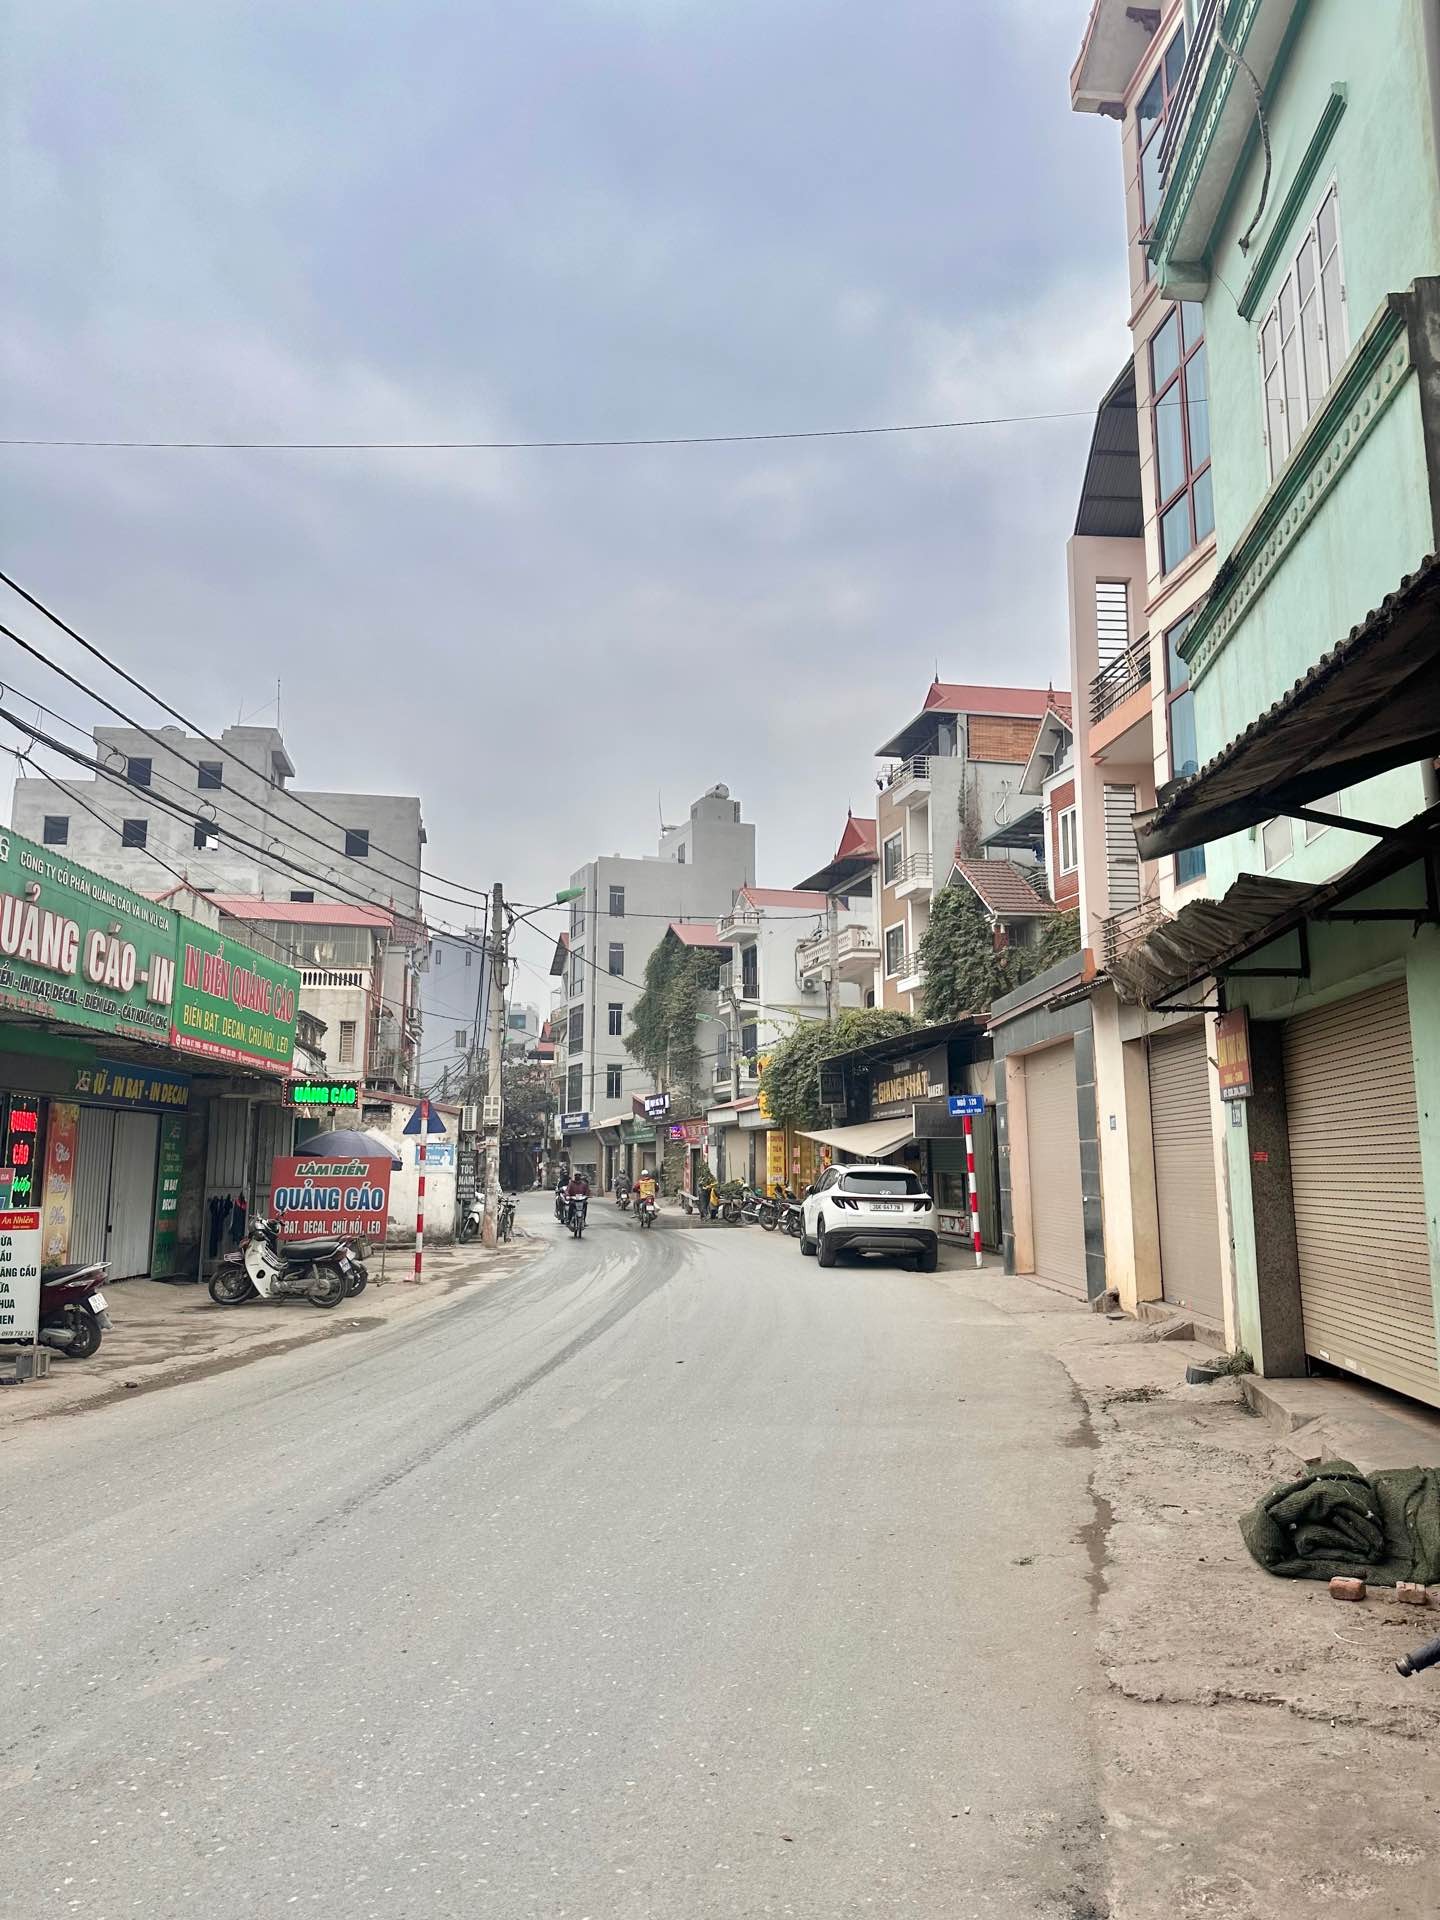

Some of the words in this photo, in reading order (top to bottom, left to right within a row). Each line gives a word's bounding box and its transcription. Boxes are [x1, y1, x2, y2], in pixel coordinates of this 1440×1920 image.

[46, 863, 57, 879] TY
[141, 908, 150, 923] IN
[0, 881, 80, 974] UẢNG
[86, 922, 137, 993] CÁO
[150, 955, 176, 1006] IN
[0, 960, 14, 989] ỂN
[51, 982, 78, 1007] DECAL
[183, 943, 202, 991] IN
[202, 941, 231, 1001] BIỂN
[232, 960, 273, 1016] QUẢNG
[273, 979, 295, 1025] CÁO
[330, 1082, 356, 1104] CÁO
[12, 1139, 30, 1165] CÁO
[295, 1160, 333, 1177] LÀM
[331, 1158, 369, 1177] BIỂN
[274, 1179, 342, 1212] QUẢNG
[344, 1181, 385, 1212] CÁO
[367, 1220, 381, 1234] LED
